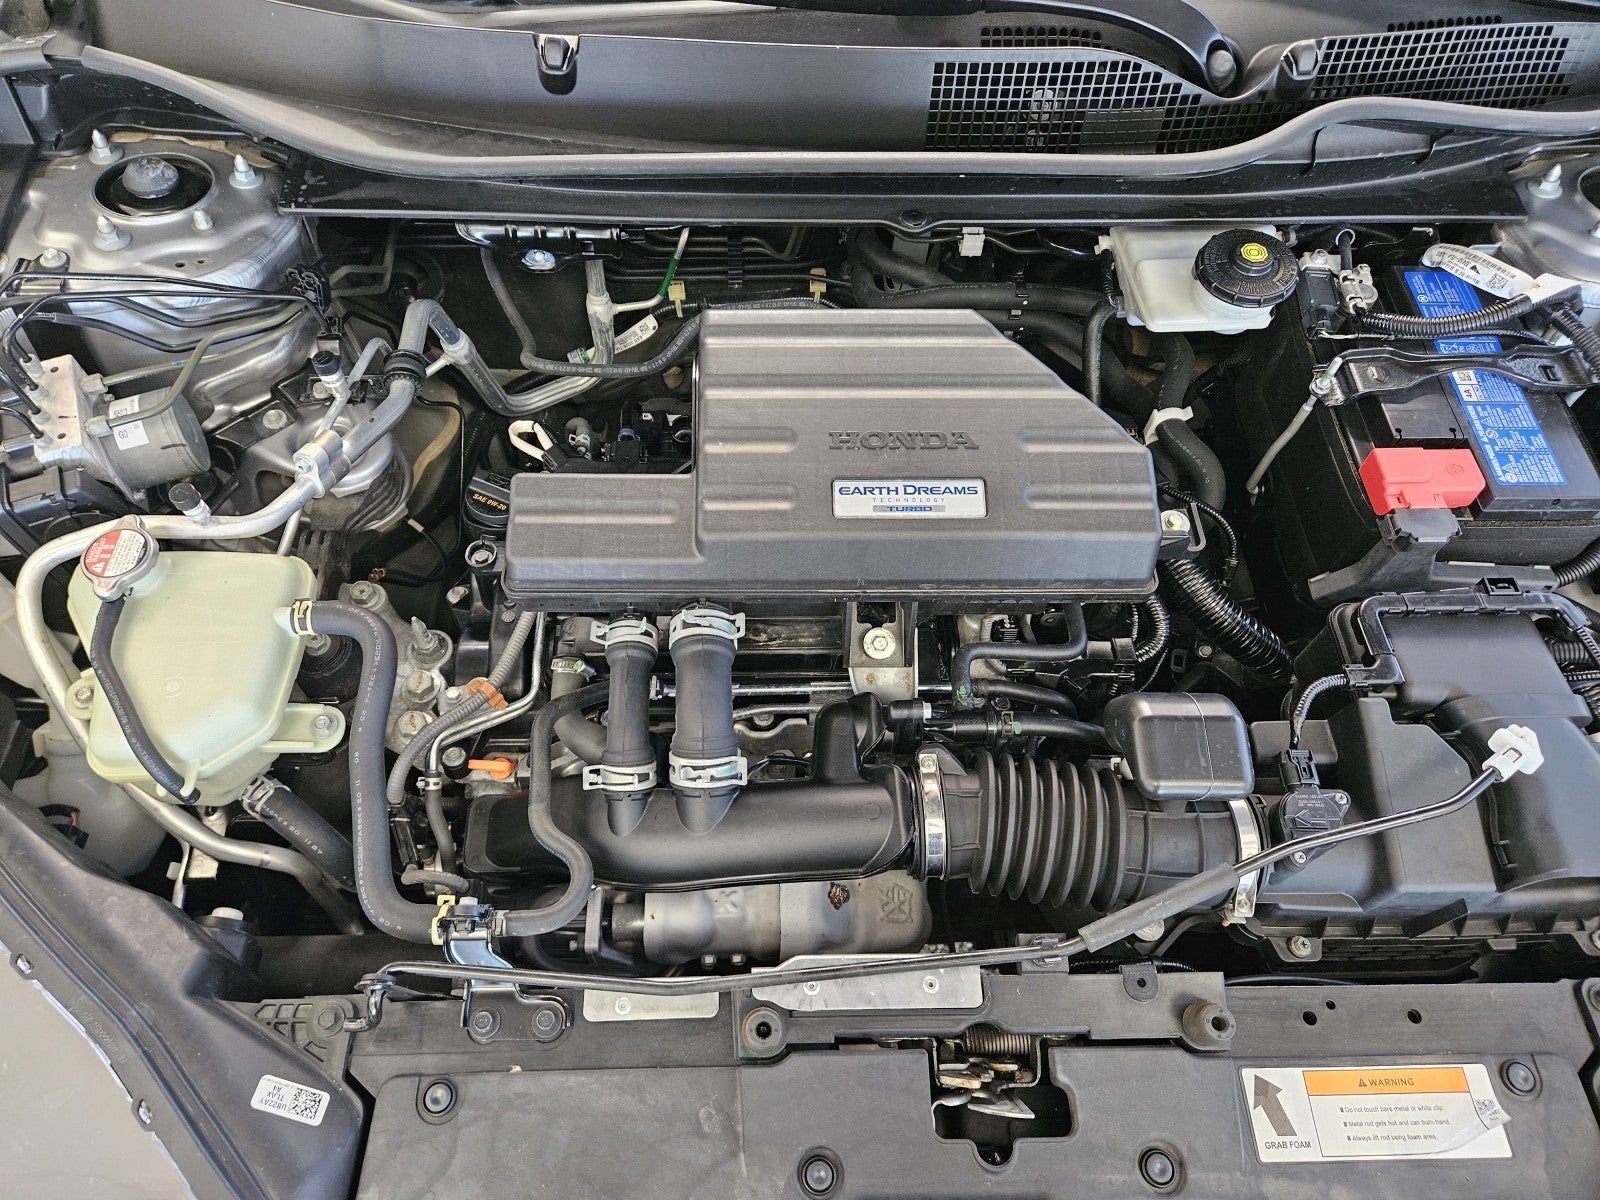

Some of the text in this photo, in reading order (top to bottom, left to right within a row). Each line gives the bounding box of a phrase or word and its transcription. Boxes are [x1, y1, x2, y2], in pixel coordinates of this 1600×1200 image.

[828, 431, 979, 450] HONDA
[838, 485, 978, 495] EARTH DREAMS
[472, 493, 487, 503] SAE
[1368, 1078, 1415, 1087] WARNING
[1363, 1105, 1378, 1113] touch
[1352, 1134, 1372, 1142] Always
[1264, 1140, 1312, 1150] GRAB FOAM
